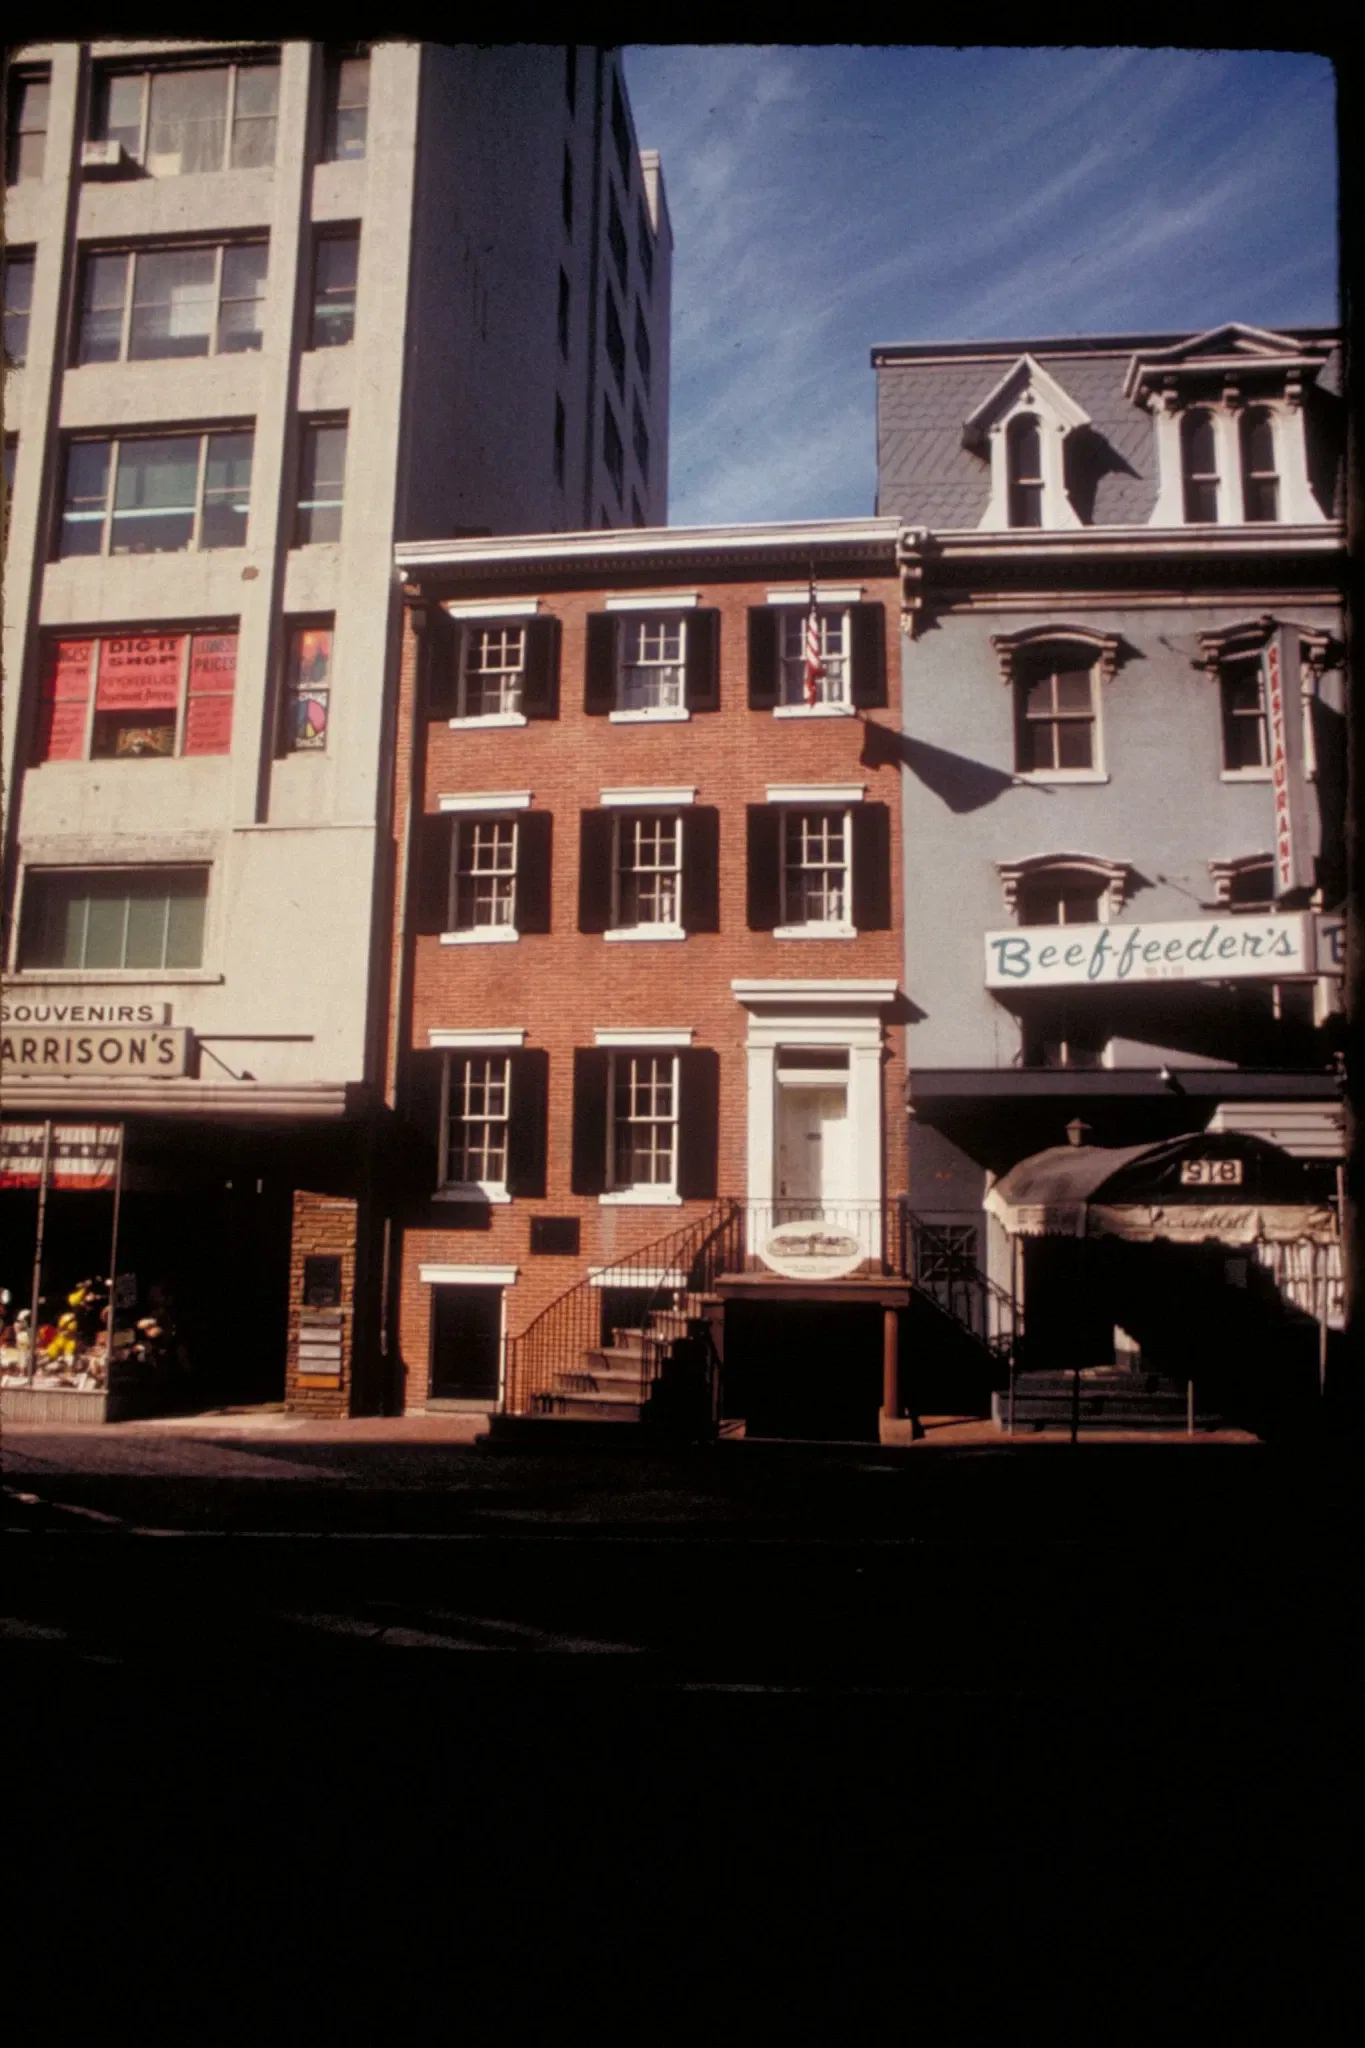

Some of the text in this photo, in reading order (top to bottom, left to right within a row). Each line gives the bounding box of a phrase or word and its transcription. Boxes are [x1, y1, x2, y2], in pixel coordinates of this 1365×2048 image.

[108, 655, 177, 667] SHOP
[1266, 647, 1290, 885] RESTAURANT
[0, 1005, 153, 1022] SOUVENIRS
[0, 1033, 175, 1064] ARRISON'S
